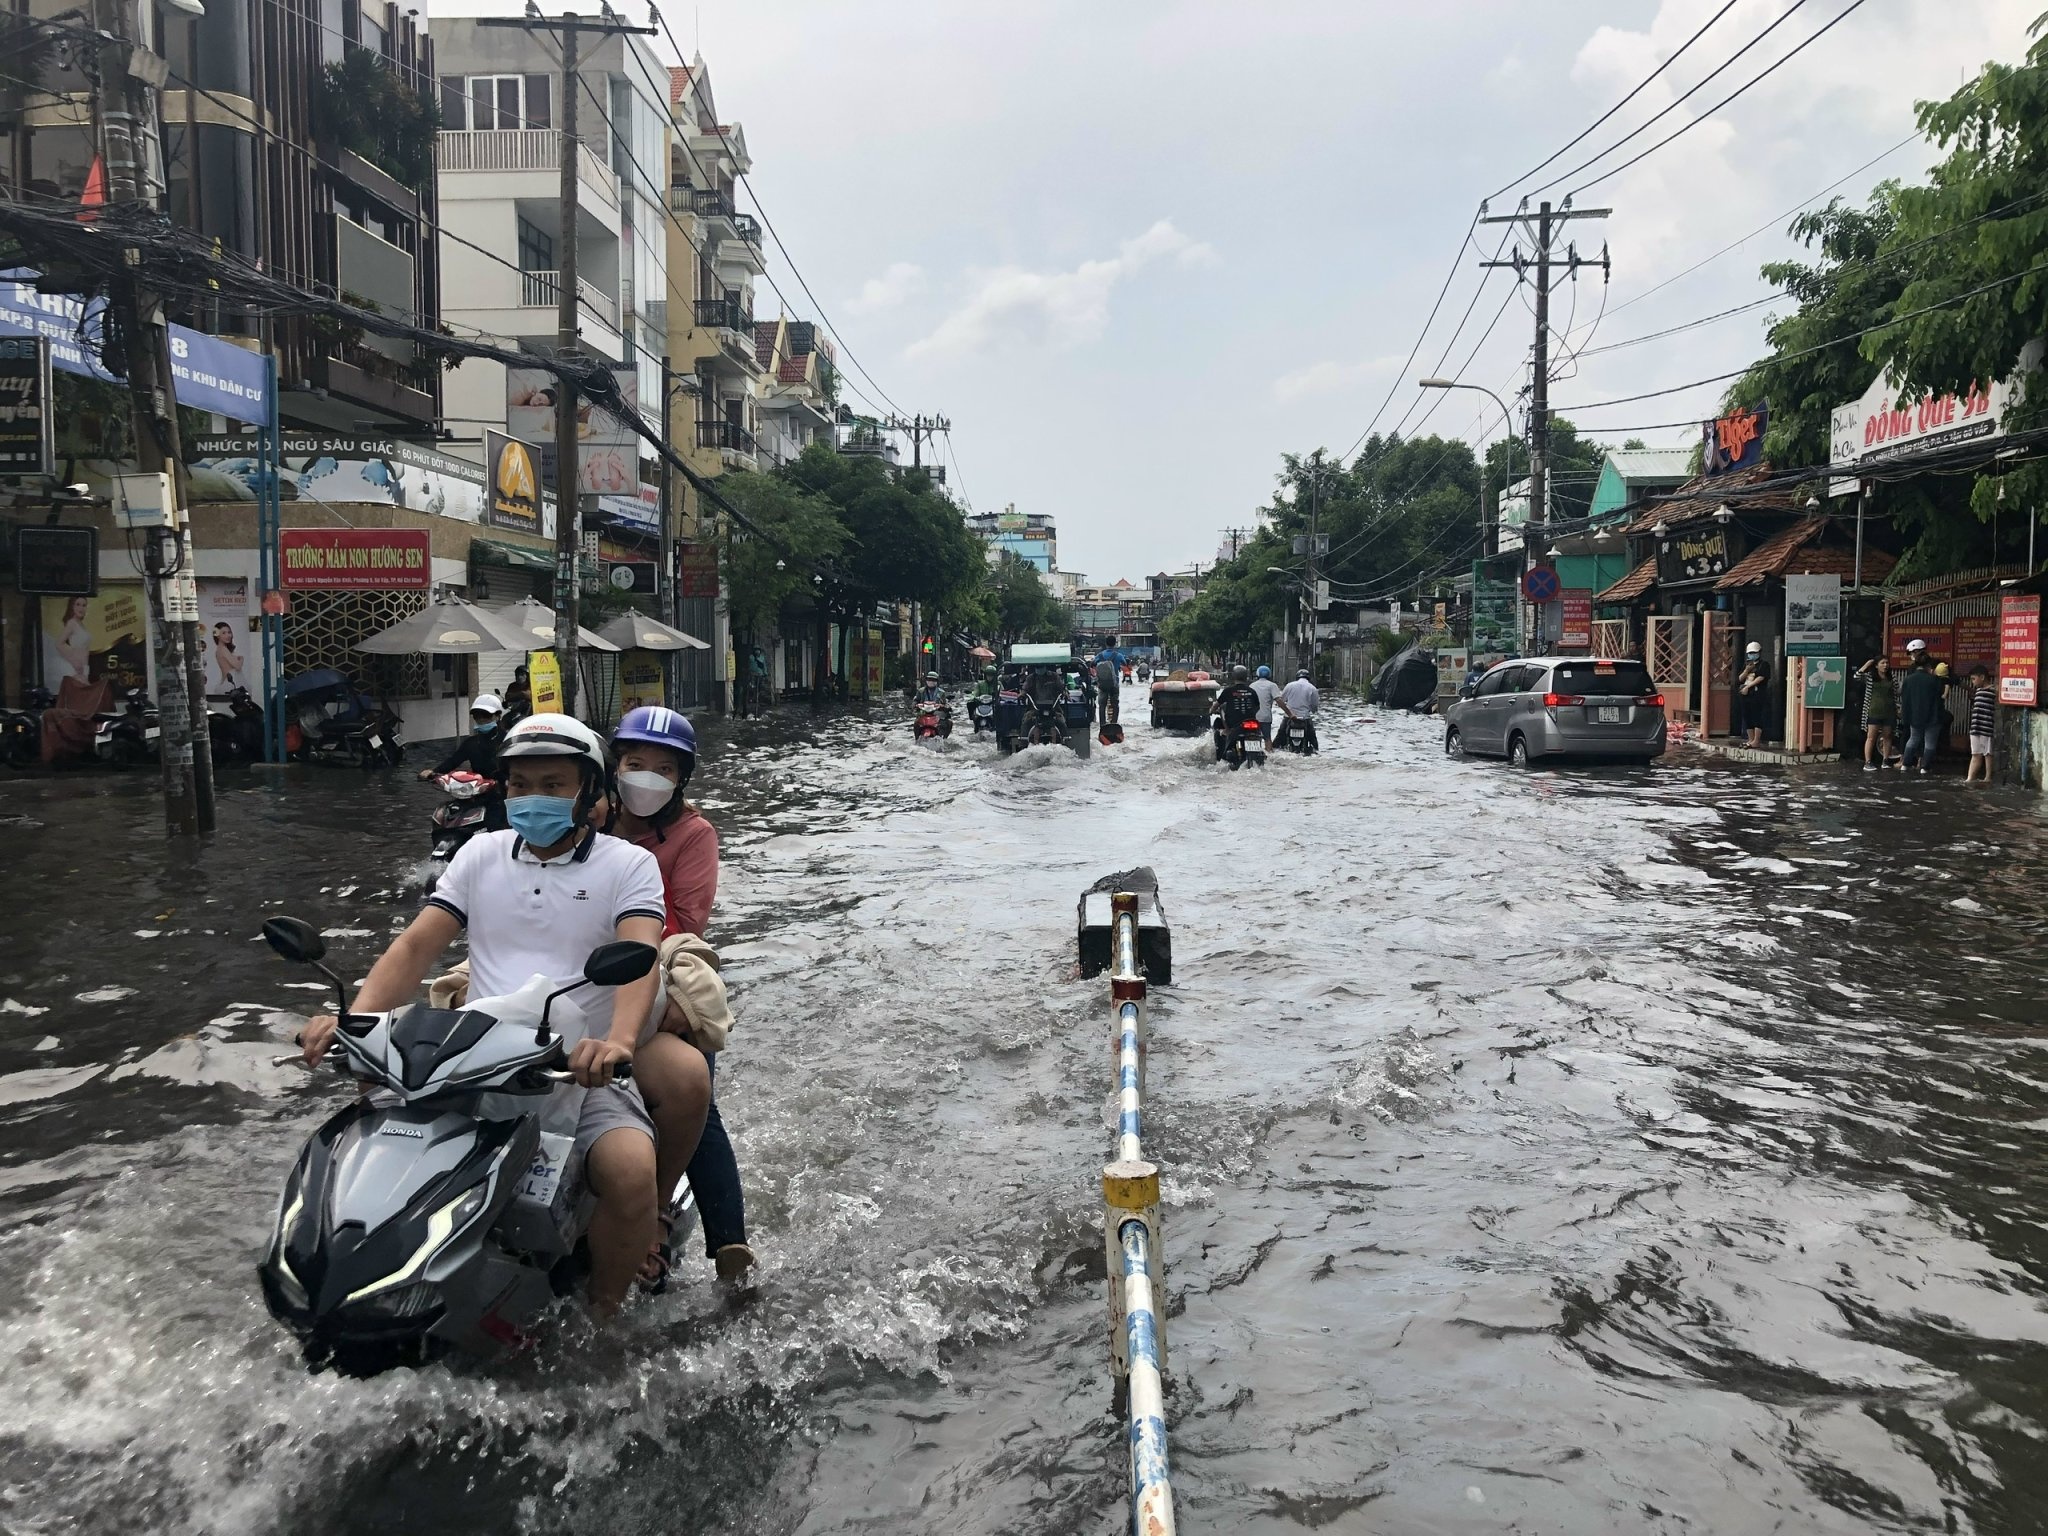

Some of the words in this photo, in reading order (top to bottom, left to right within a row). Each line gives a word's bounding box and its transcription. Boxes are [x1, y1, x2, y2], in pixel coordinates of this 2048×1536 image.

[171, 337, 188, 358] 8
[193, 370, 216, 388] KHU
[219, 379, 243, 397] DÂN
[1716, 406, 1758, 462] Tiger
[197, 439, 241, 452] NHỨC
[402, 448, 412, 460] 60
[445, 461, 460, 474] 1000
[286, 542, 324, 568] TRƯỜNG
[349, 548, 369, 568] NON
[371, 545, 403, 568] HƯƠNG
[405, 548, 424, 568] SEN
[1698, 558, 1710, 574] 3
[107, 654, 119, 669] 5
[381, 1127, 424, 1139] HONDA
